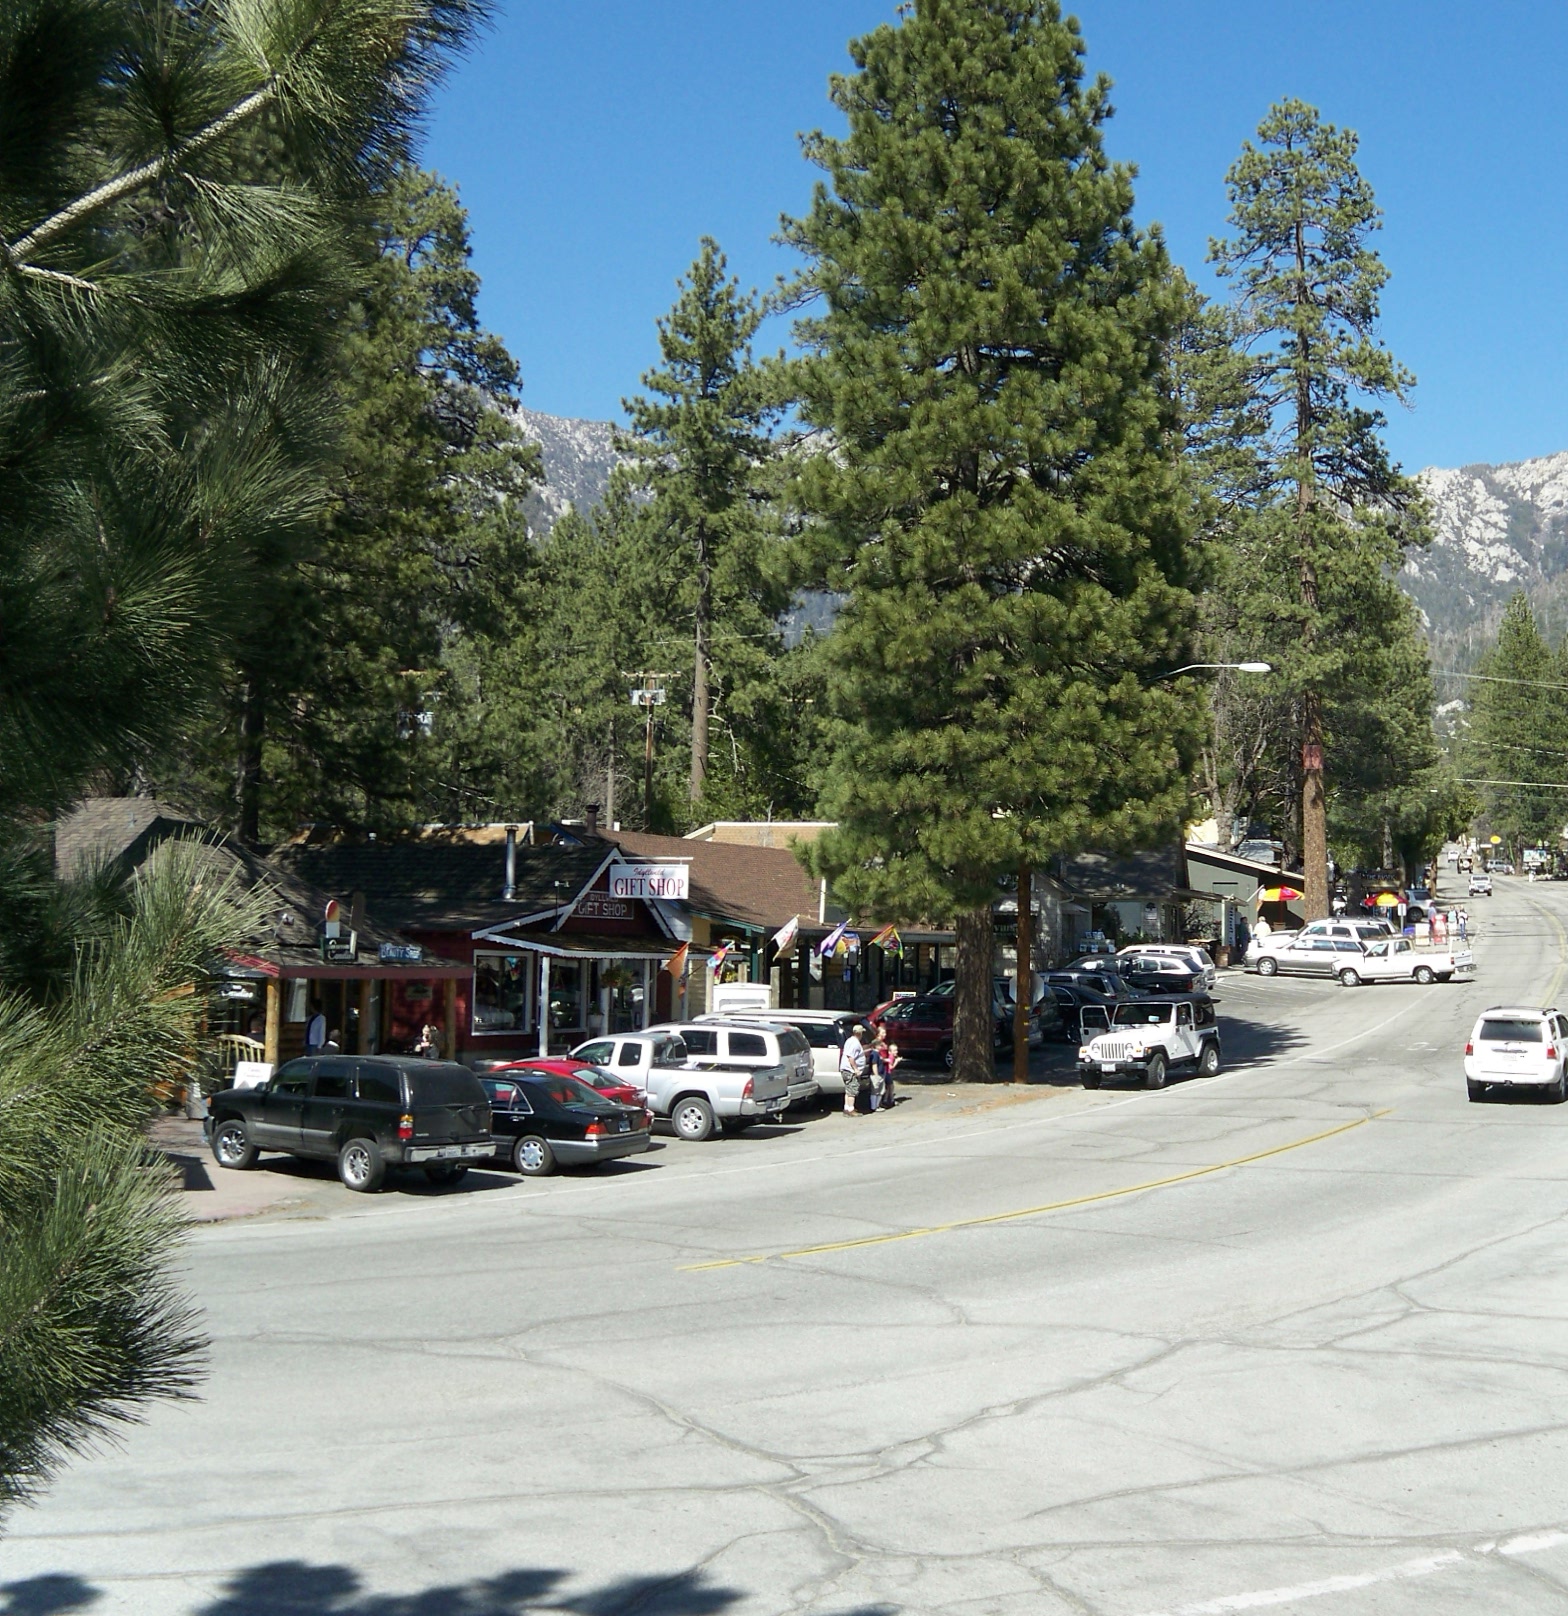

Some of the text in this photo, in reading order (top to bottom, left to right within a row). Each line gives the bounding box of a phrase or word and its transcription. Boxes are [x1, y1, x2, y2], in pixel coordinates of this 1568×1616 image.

[614, 878, 685, 896] GIFT SHOP
[578, 902, 627, 916] GIFT SHOP
